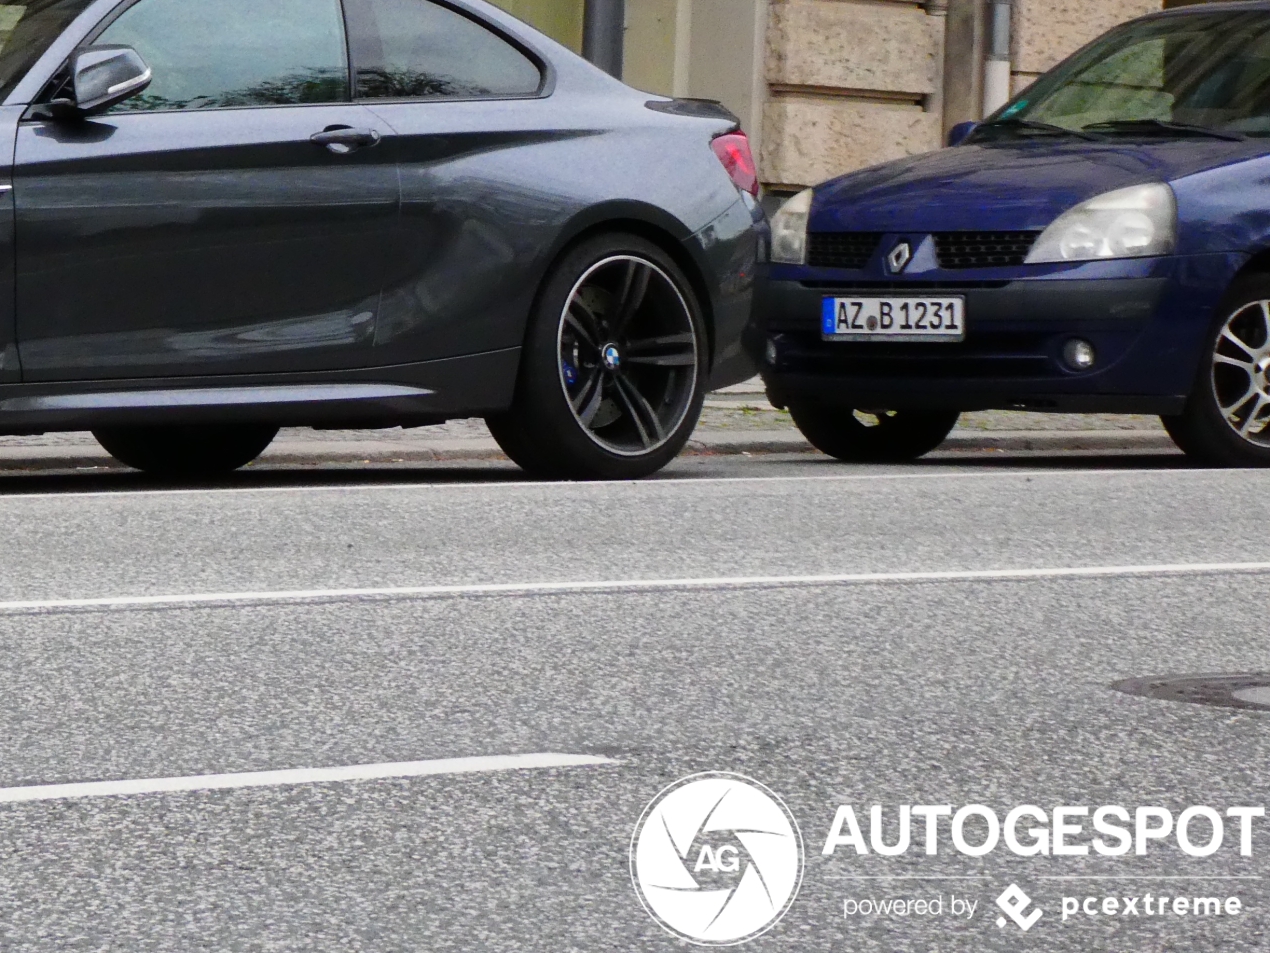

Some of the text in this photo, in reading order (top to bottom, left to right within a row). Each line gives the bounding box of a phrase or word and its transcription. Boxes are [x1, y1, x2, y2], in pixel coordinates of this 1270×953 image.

[836, 301, 959, 330] AZ B 1231
